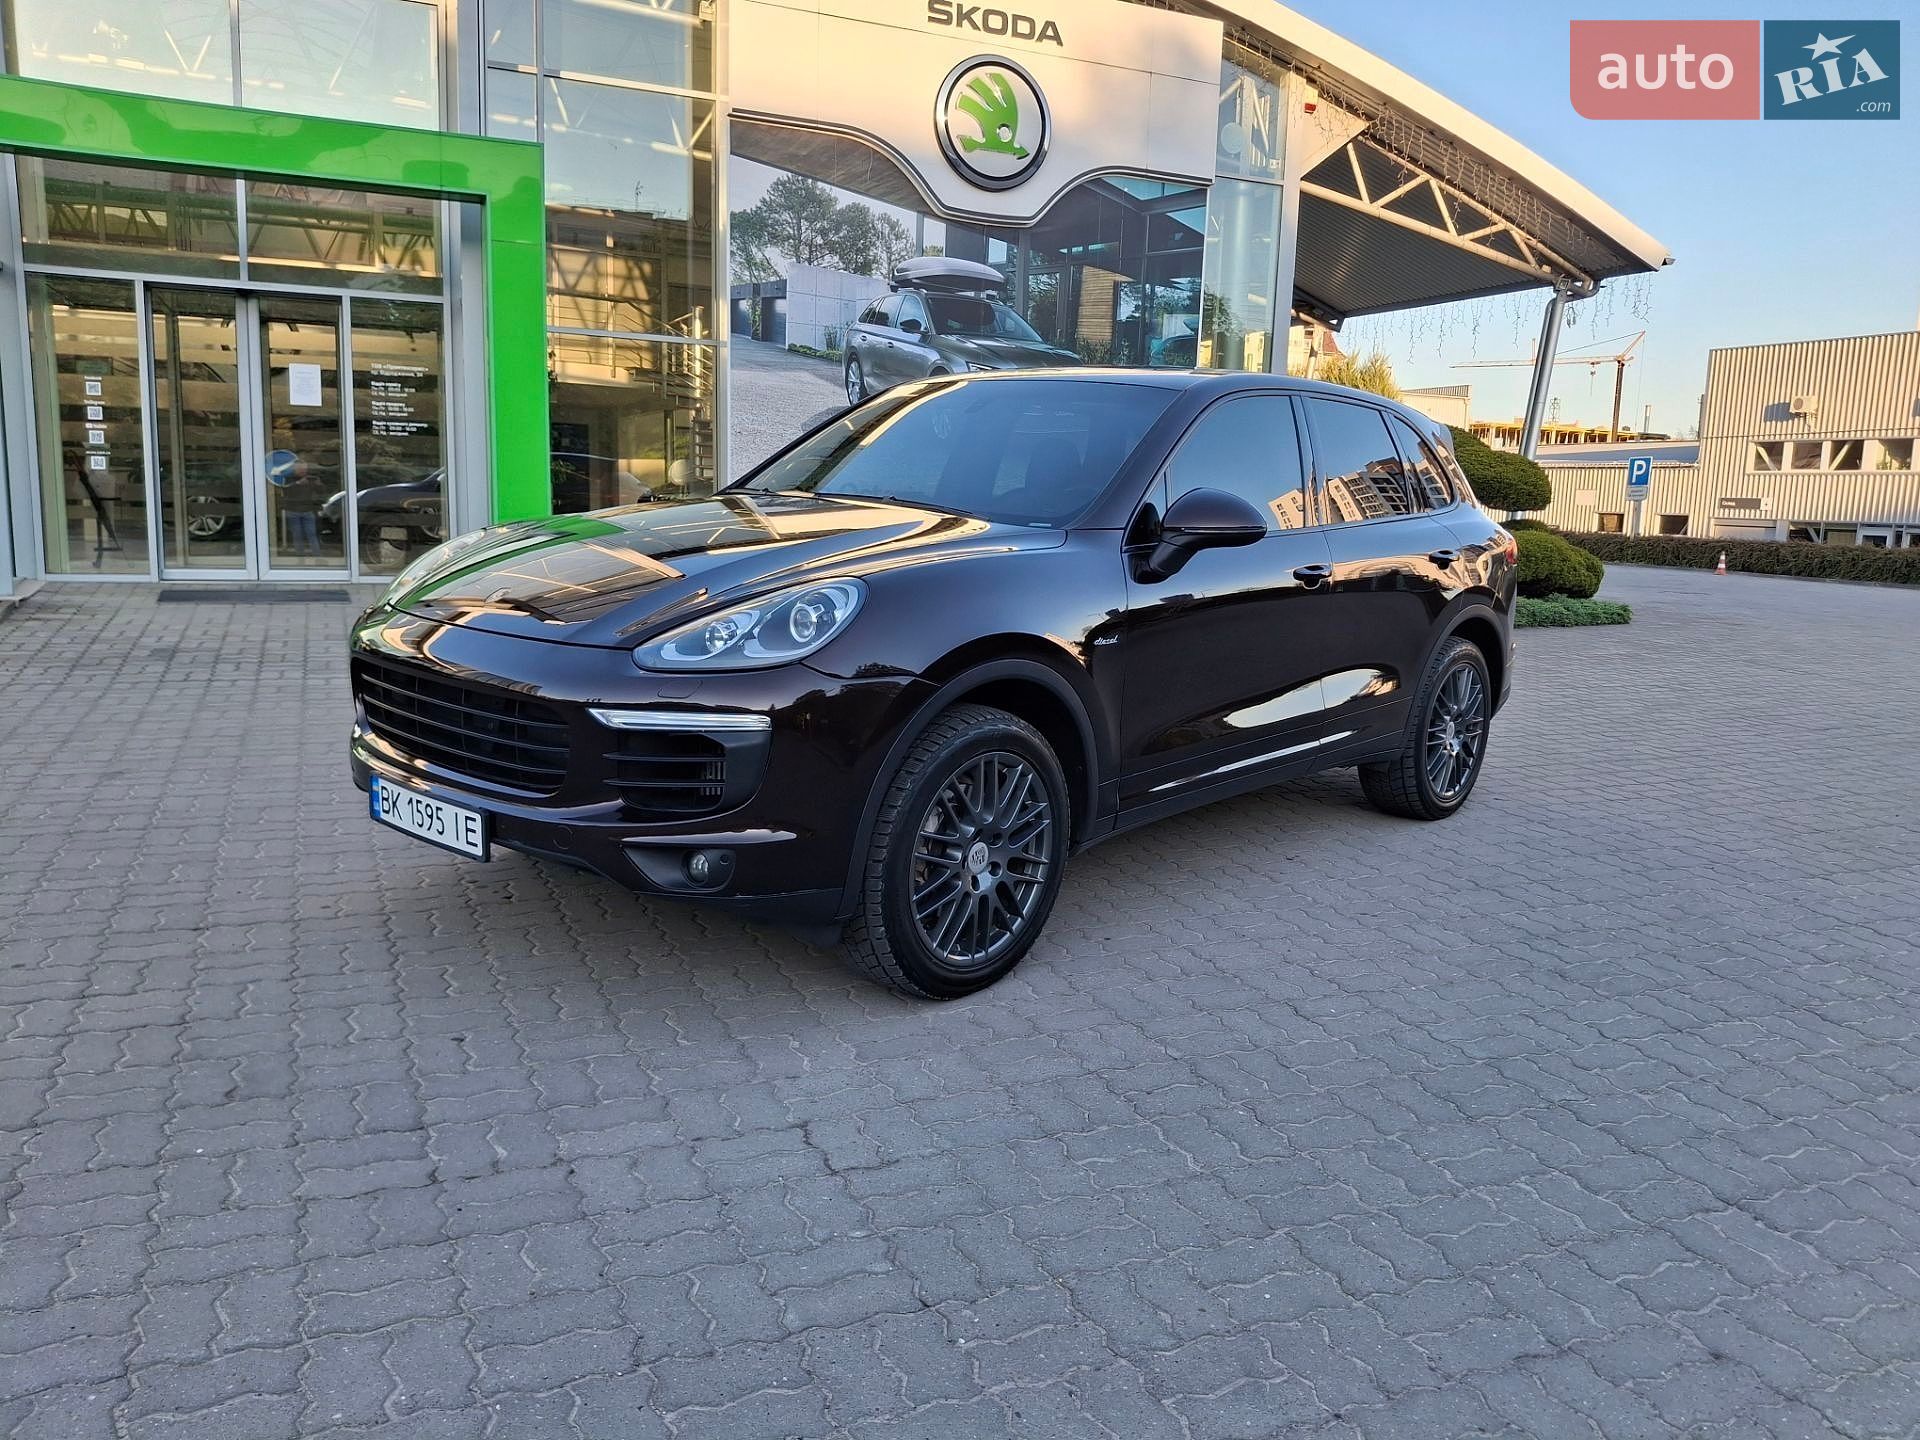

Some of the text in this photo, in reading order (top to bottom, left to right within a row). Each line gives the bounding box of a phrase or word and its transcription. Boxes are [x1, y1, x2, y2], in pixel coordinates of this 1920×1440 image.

[1631, 460, 1647, 483] P
[1093, 634, 1119, 646] diesel
[380, 785, 479, 848] BK 1595 IE
